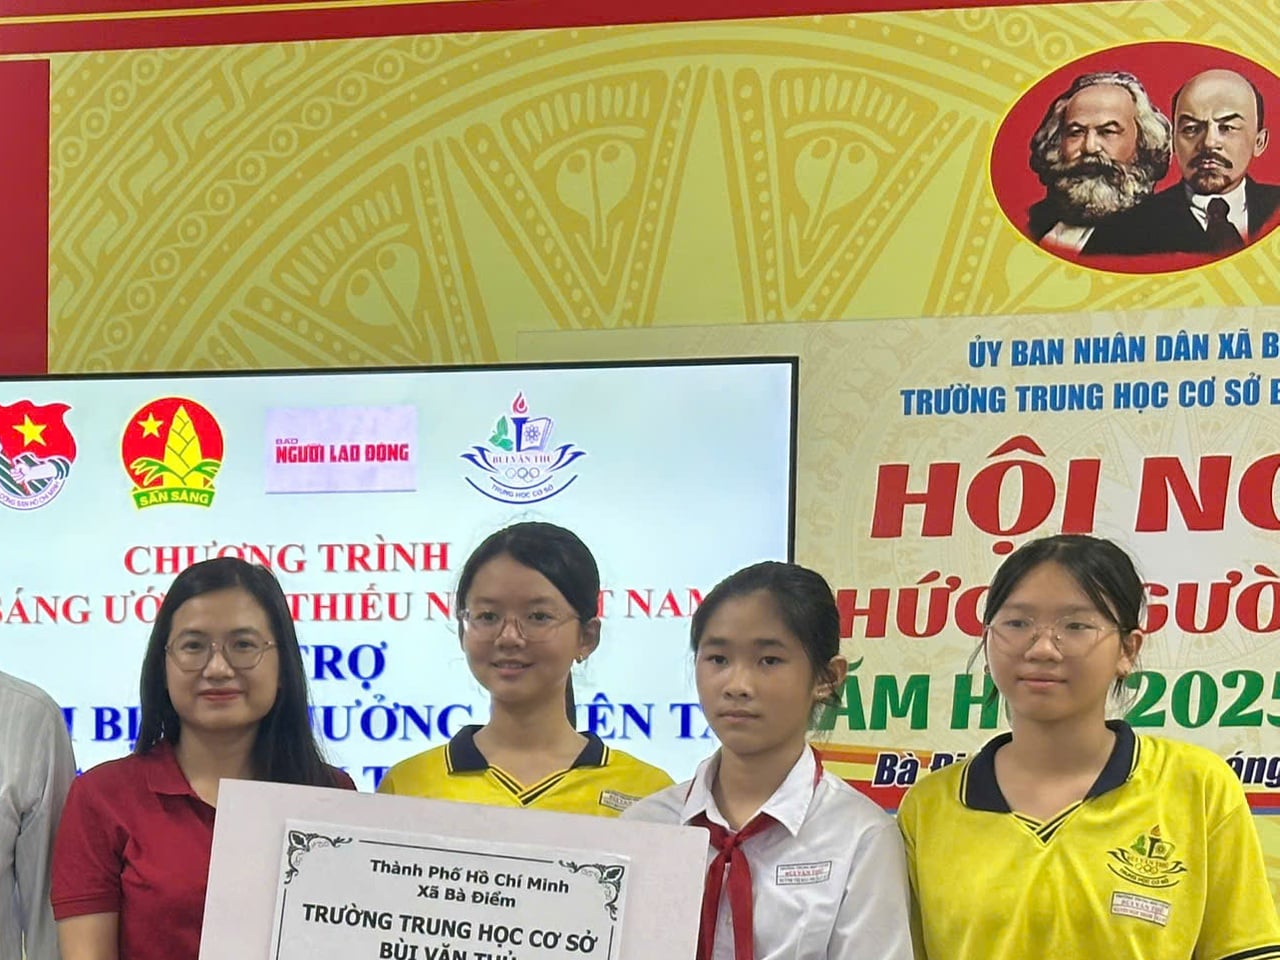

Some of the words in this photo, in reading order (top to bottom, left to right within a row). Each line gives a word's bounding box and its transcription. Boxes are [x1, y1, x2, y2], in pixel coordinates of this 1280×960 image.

[969, 335, 1003, 368] ỦY
[1011, 338, 1064, 367] BAN
[1074, 332, 1146, 364] NHÂN
[1155, 330, 1209, 362] DÂN
[1218, 328, 1253, 360] XÃ
[900, 383, 1006, 416] TRƯỜNG
[1015, 383, 1103, 413] TRUNG
[1114, 380, 1169, 414] HỌC
[1178, 376, 1216, 408] CƠ
[1224, 372, 1262, 406] SỞ
[329, 444, 361, 463] LAO
[870, 434, 1102, 555] HỘI
[318, 533, 452, 572] TRÌNH
[285, 583, 414, 622] THIẾU
[299, 640, 388, 690] RỢ
[873, 752, 920, 787] Bà
[370, 859, 422, 878] Thành
[428, 865, 463, 882] Phố
[466, 869, 489, 886] Hồ
[494, 873, 522, 889] Chí
[526, 877, 570, 894] Minh
[417, 884, 440, 900] Xã
[444, 887, 466, 902] Bà
[471, 890, 517, 908] Điểm
[302, 902, 393, 931] TRƯỜNG
[398, 914, 471, 939] TRUNG
[478, 923, 523, 948] HỌC
[528, 929, 562, 950] CƠ
[565, 929, 599, 954] SỞ
